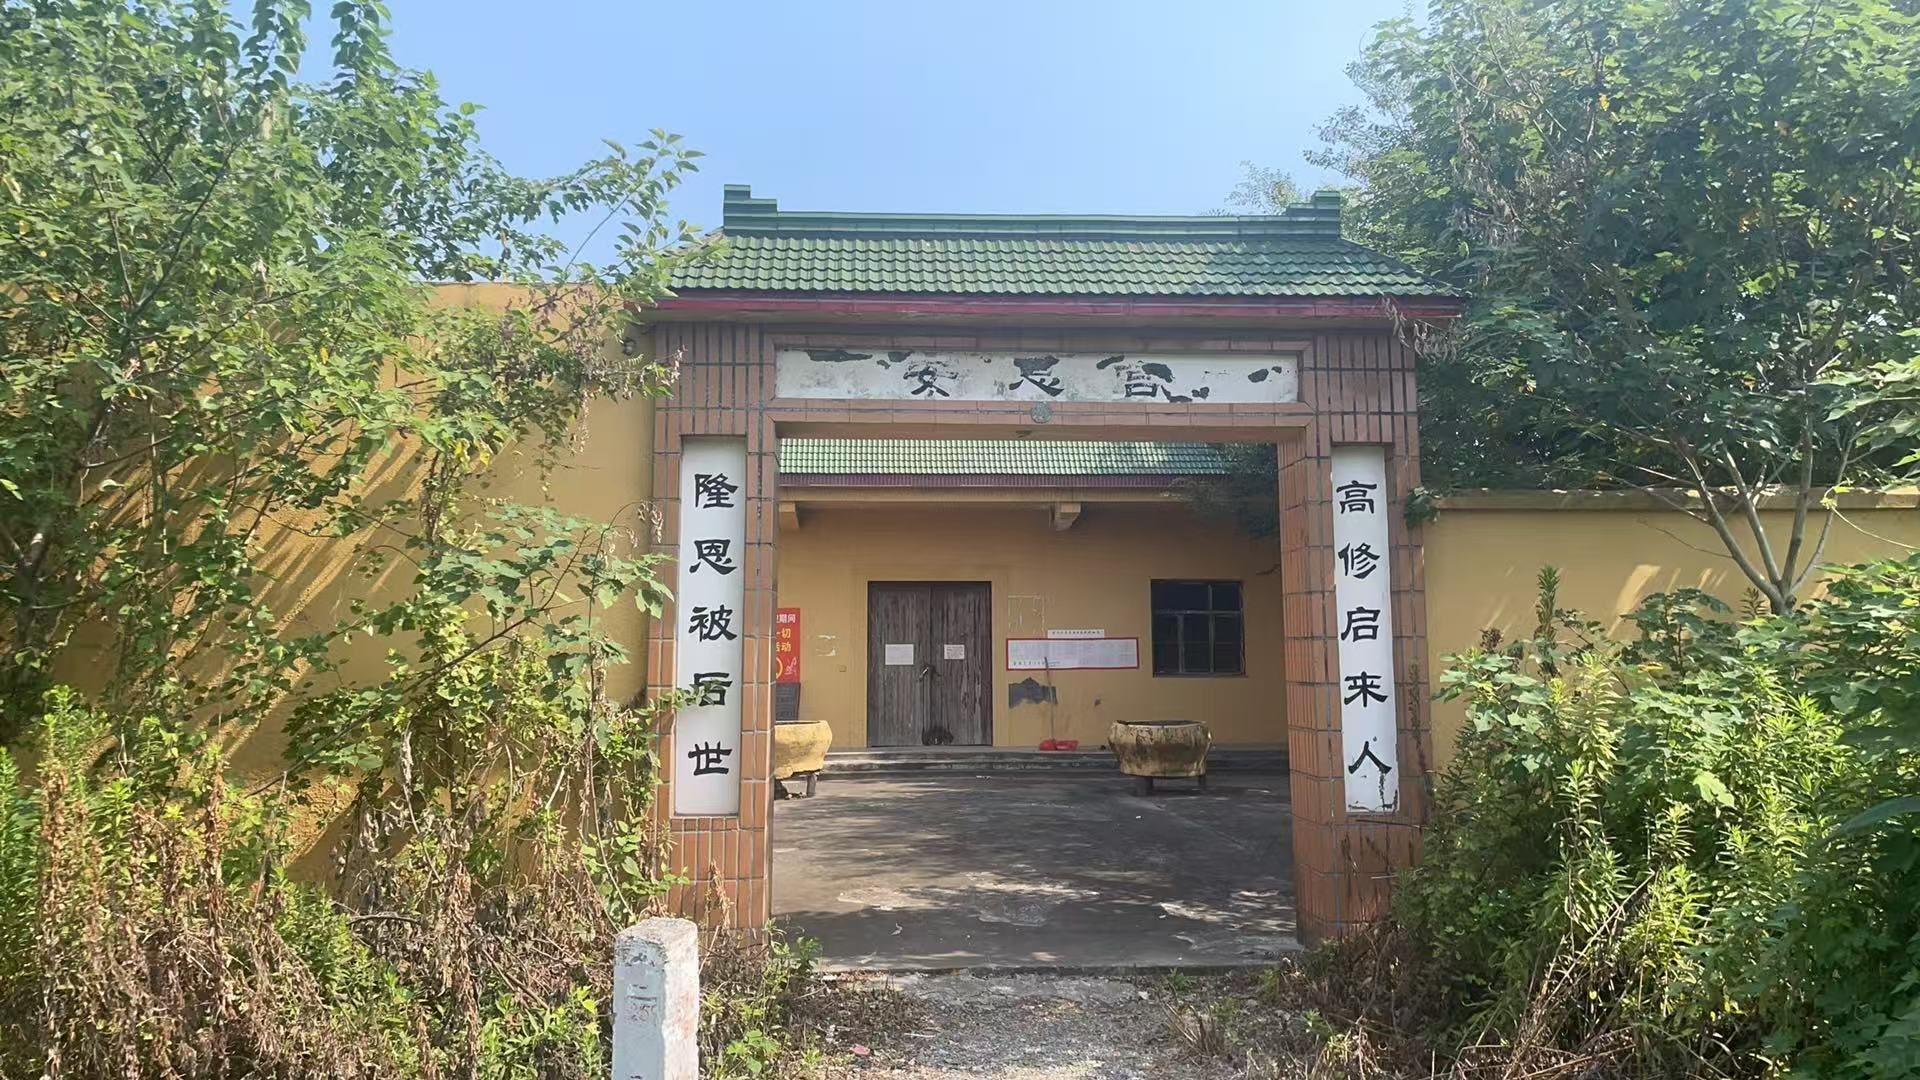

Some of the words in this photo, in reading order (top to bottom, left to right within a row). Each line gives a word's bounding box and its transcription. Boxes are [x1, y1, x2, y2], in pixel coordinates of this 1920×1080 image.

[688, 472, 738, 776] 隆恩被后世
[1335, 479, 1393, 776] 高修启来人
